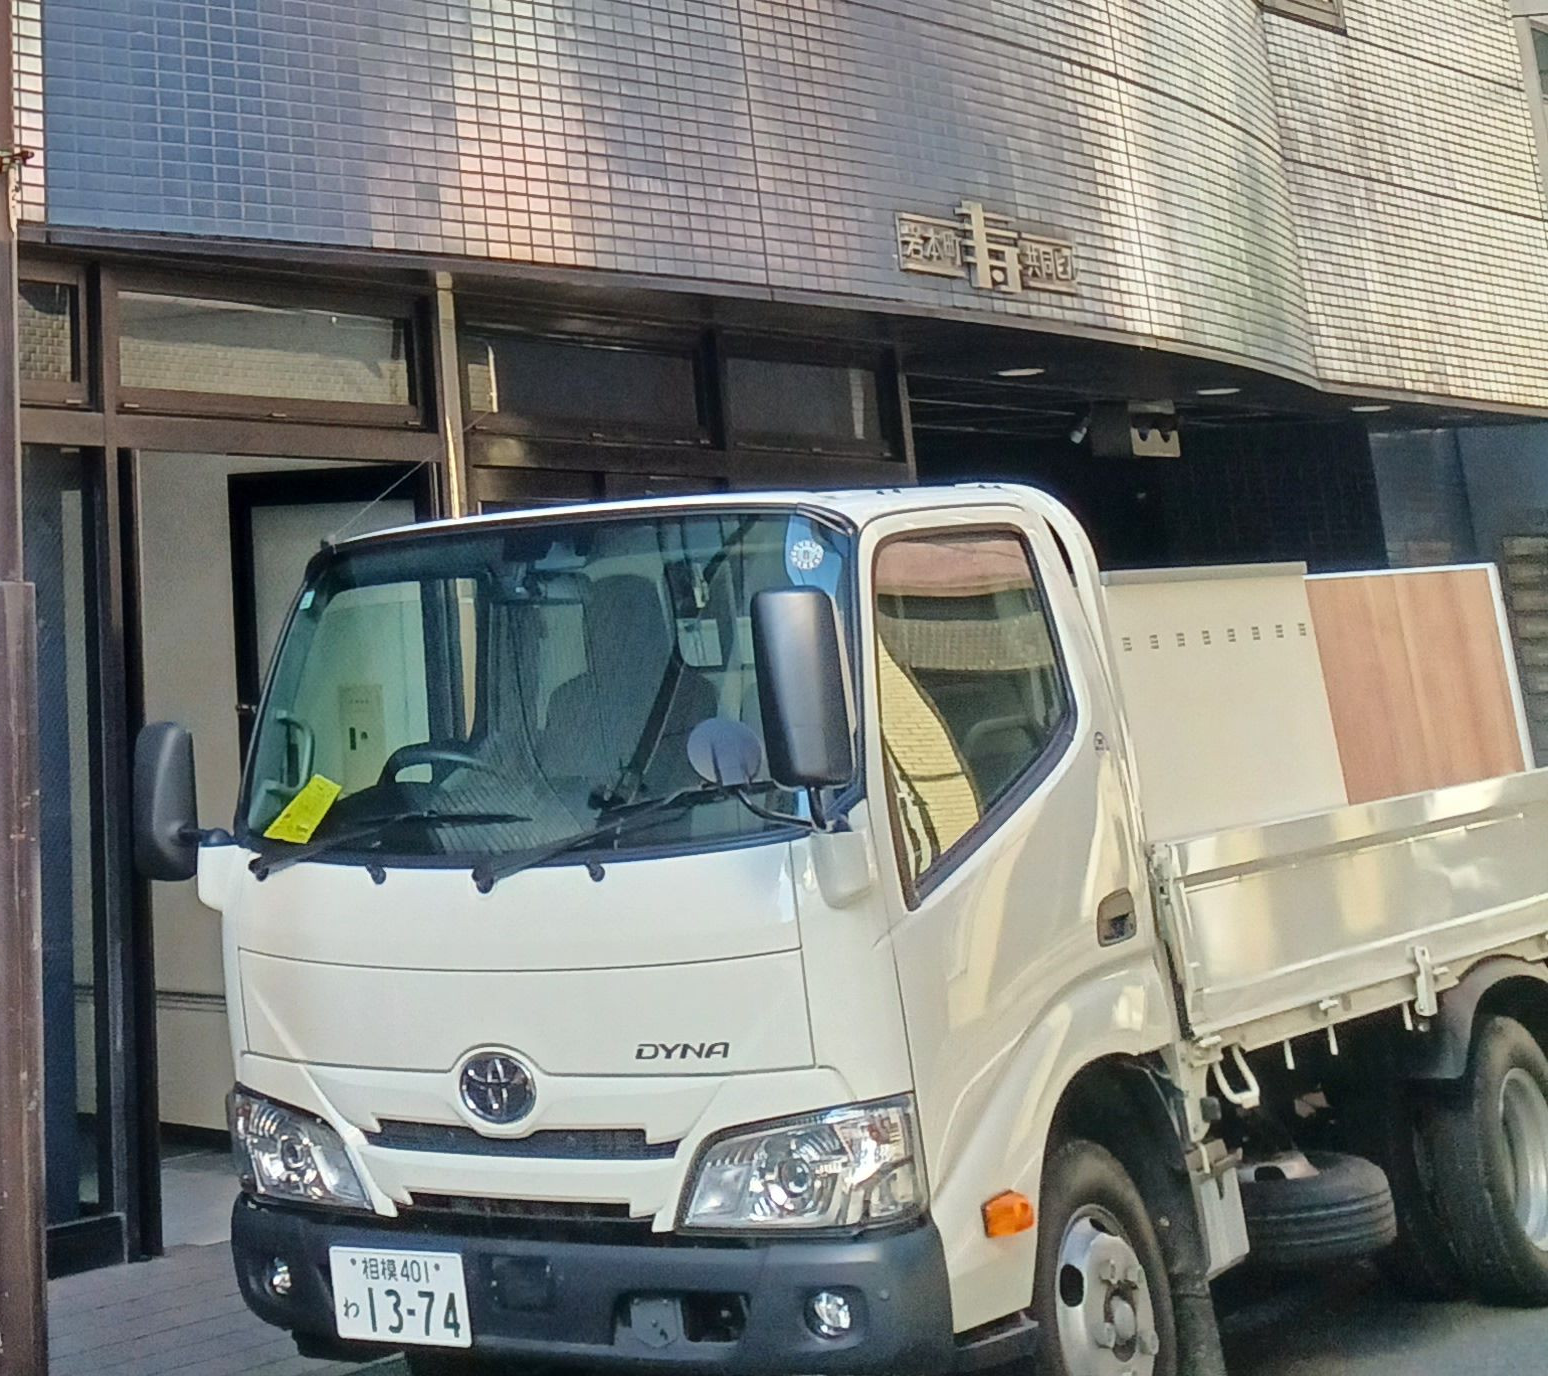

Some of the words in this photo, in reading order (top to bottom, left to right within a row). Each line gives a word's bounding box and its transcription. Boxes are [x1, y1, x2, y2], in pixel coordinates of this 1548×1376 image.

[635, 1042, 730, 1059] DYNA
[343, 1297, 360, 1320] わ
[368, 1287, 461, 1338] 13-74
